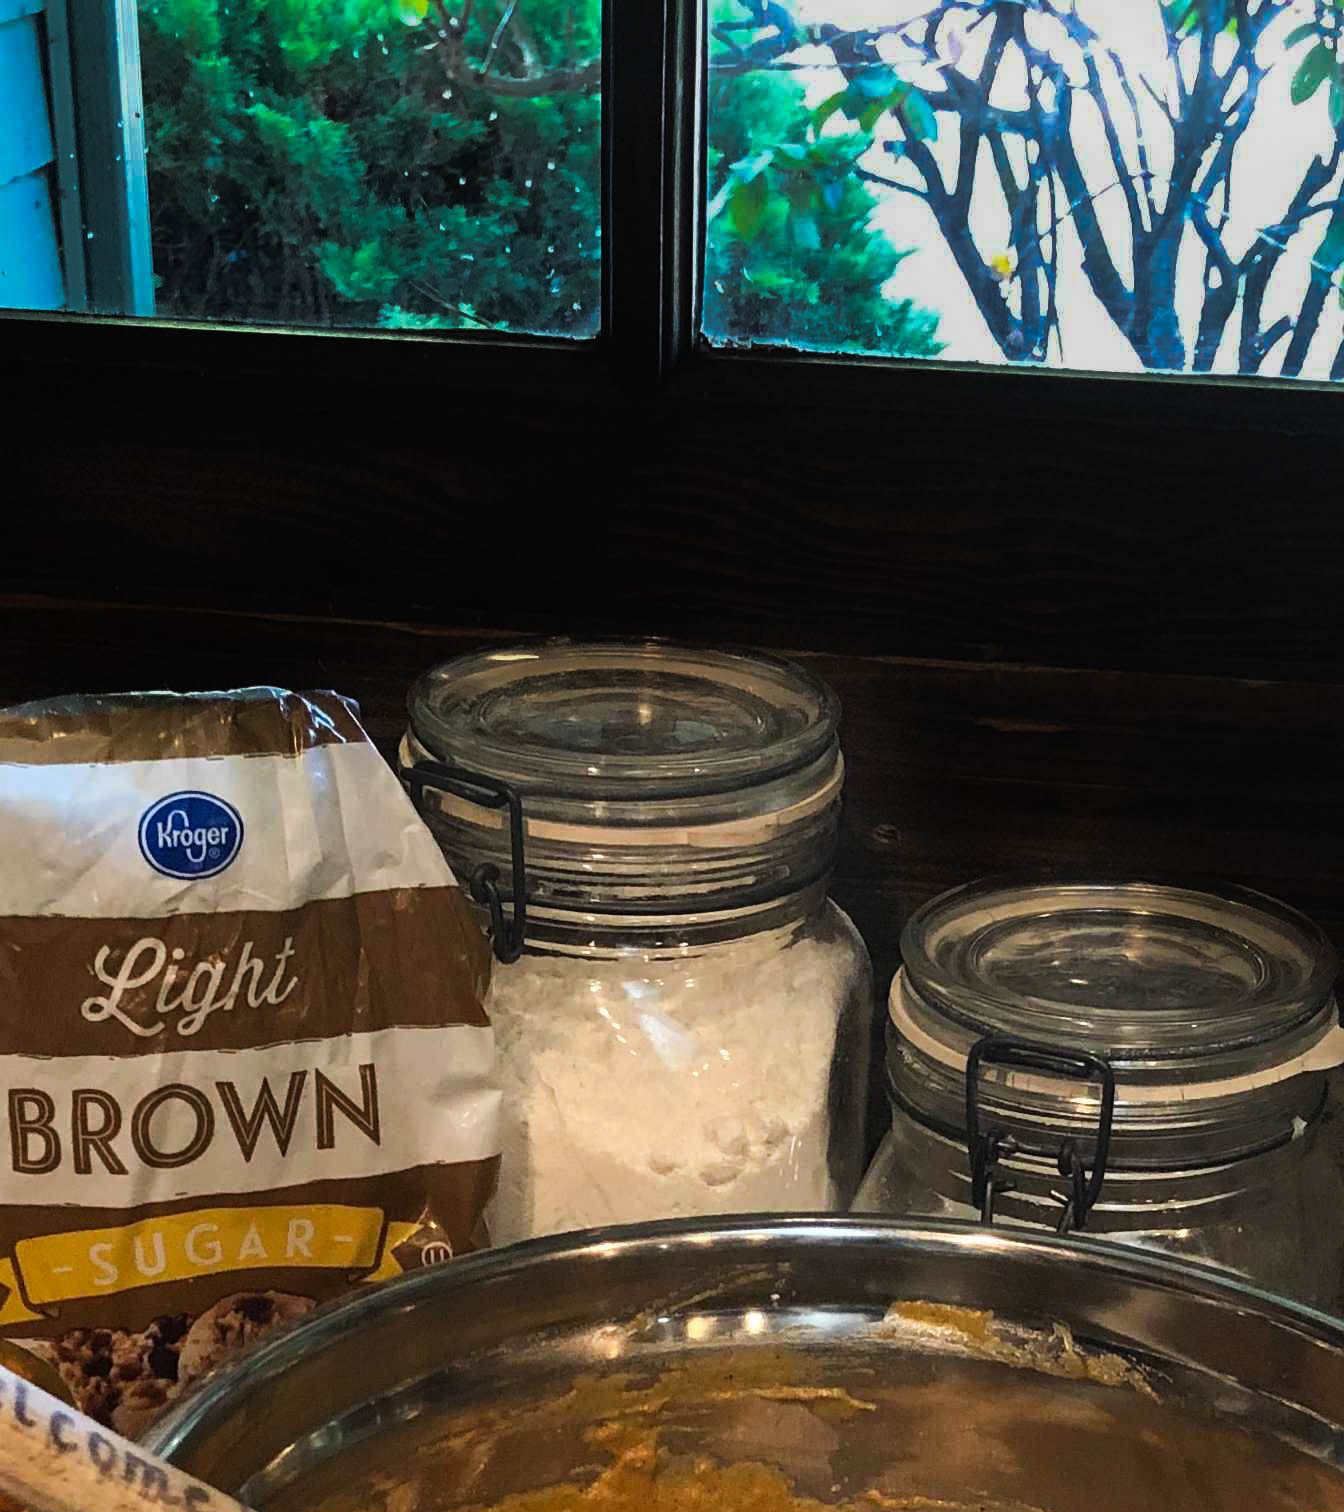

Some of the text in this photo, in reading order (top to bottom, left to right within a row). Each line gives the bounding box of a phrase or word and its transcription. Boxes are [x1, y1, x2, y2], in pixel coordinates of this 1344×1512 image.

[158, 809, 228, 863] Kroger
[81, 936, 298, 1036] Light
[8, 1063, 381, 1176] BROWN
[90, 1219, 317, 1287] SUGAR
